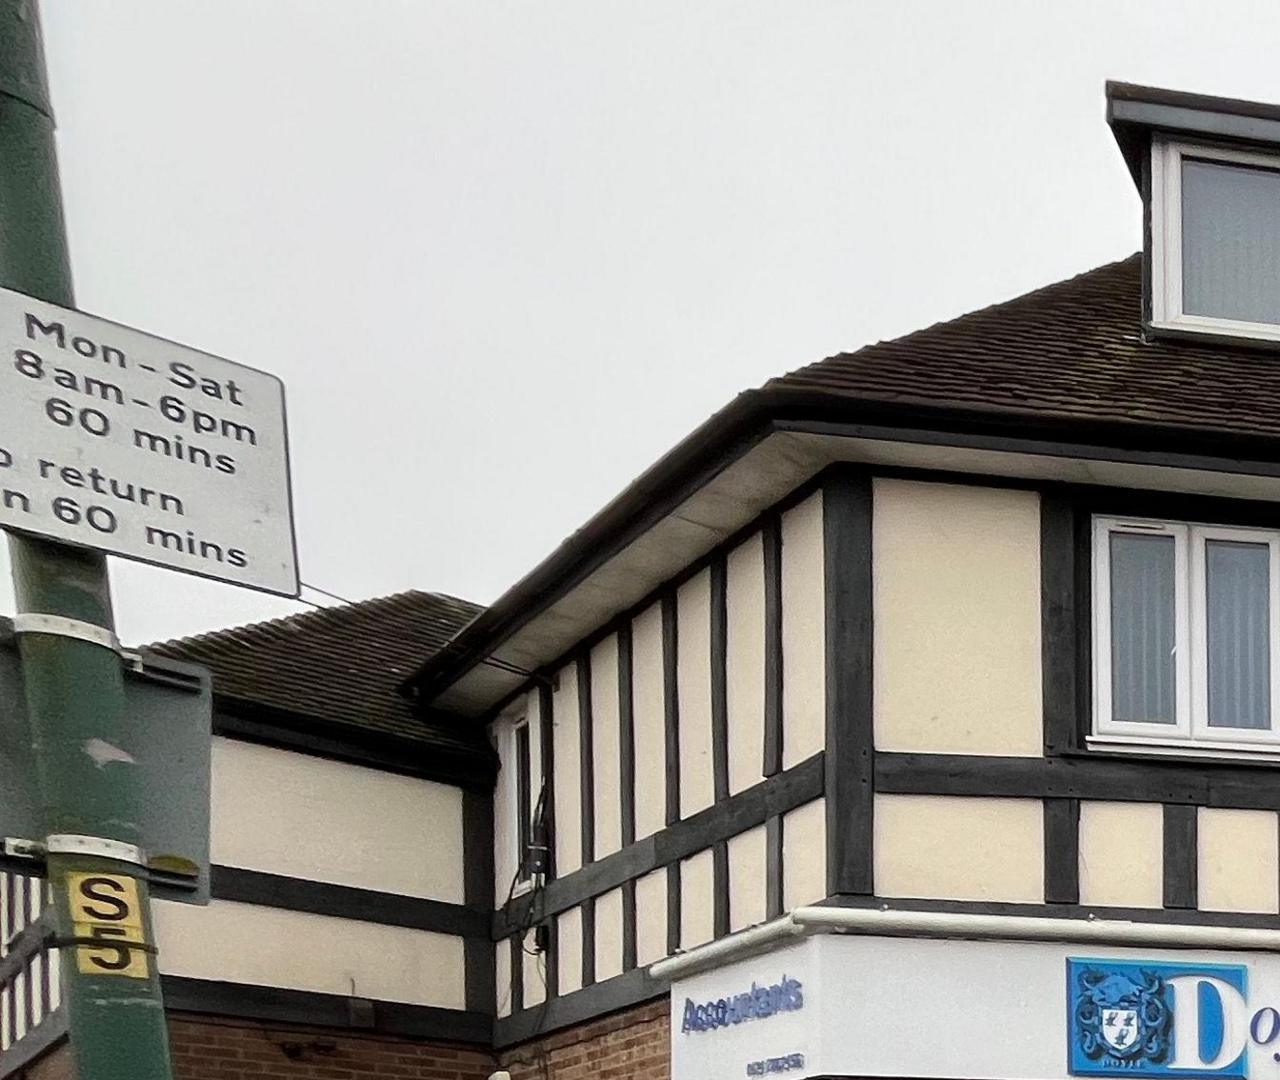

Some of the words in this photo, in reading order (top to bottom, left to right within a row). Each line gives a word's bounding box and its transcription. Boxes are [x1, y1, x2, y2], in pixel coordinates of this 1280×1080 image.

[46, 397, 110, 437] 60
[133, 428, 236, 475] mins
[40, 458, 185, 516] return
[52, 497, 118, 535] 60
[146, 524, 249, 568] mins
[80, 877, 129, 921] S
[90, 927, 131, 970] 5
[682, 974, 804, 1034] Accountants
